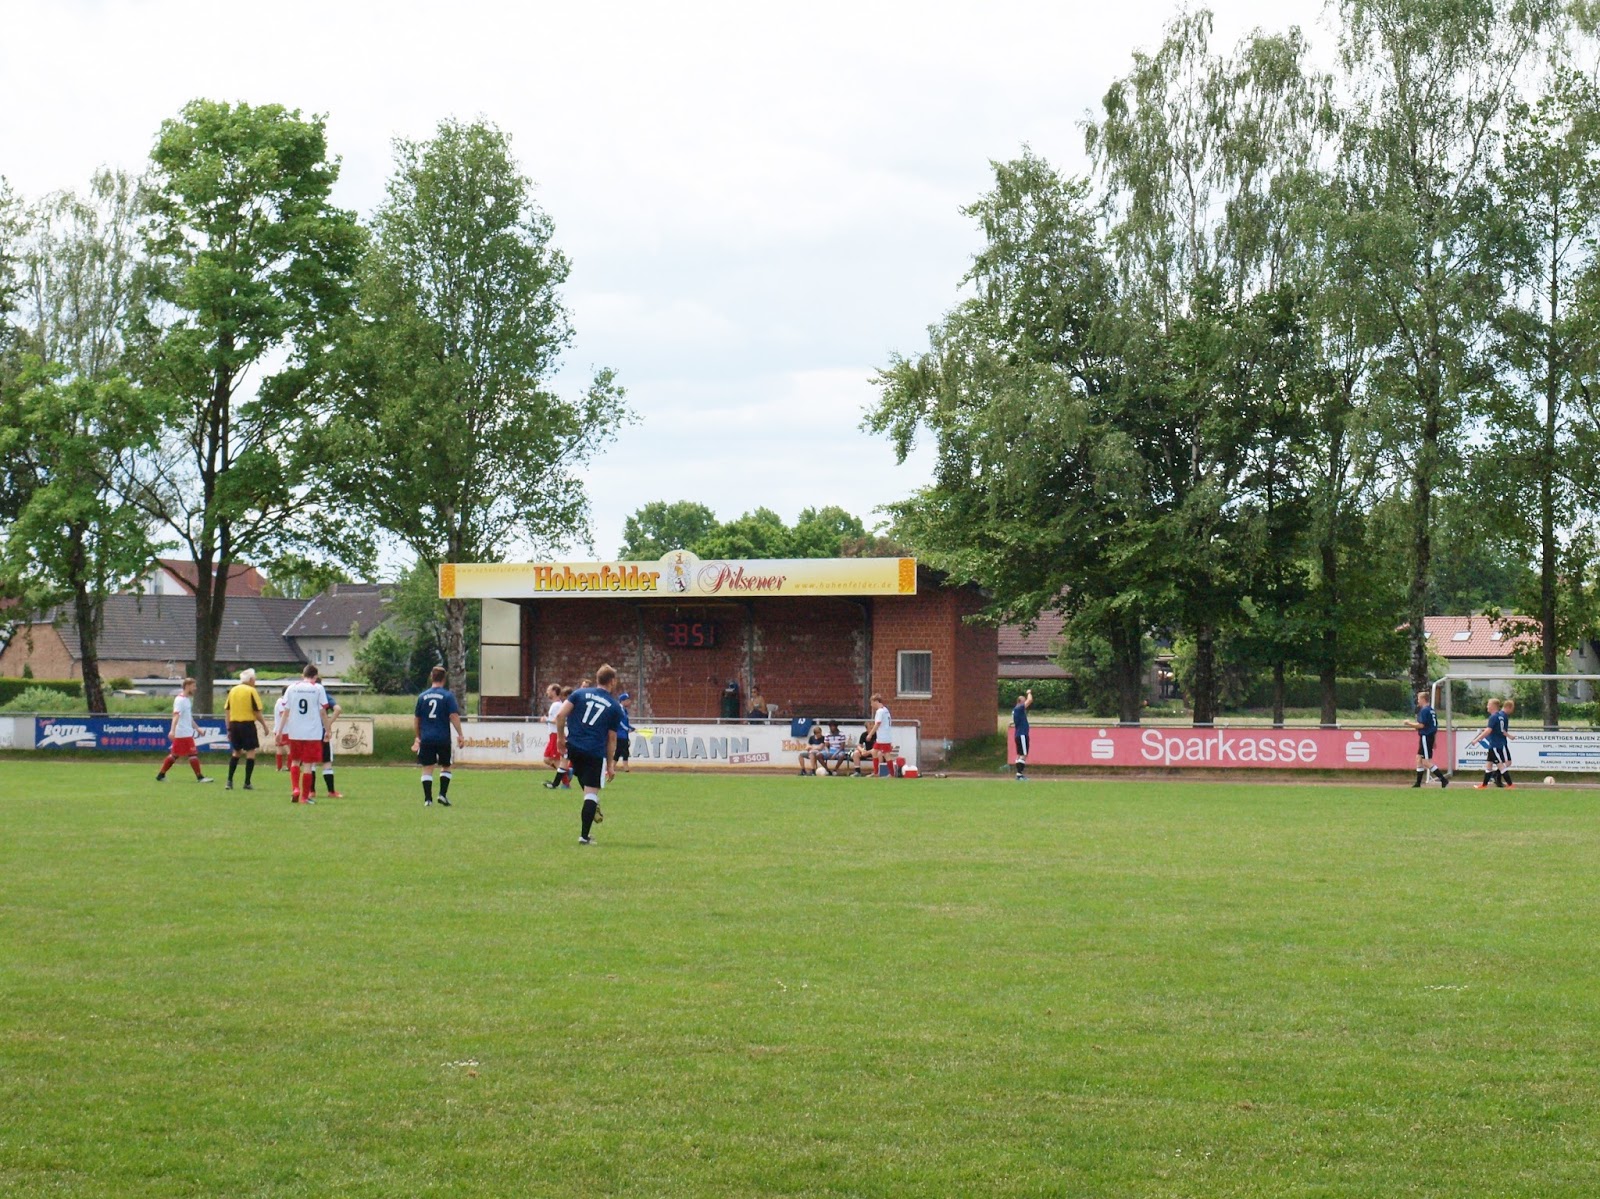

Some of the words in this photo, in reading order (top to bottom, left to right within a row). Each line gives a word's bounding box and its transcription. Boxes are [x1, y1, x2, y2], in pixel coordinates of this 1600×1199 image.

[533, 565, 660, 592] Hohenfelder
[697, 562, 787, 594] Pilsener
[298, 698, 308, 715] 9
[428, 699, 437, 718] 2
[582, 700, 606, 726] 17
[103, 724, 134, 733] Lippstadt
[644, 726, 688, 735] TRÄNKE
[458, 737, 509, 748] ohenfelder
[628, 736, 749, 759] ATMANN
[1141, 729, 1317, 765] Sparkasse
[743, 753, 767, 763] 15403
